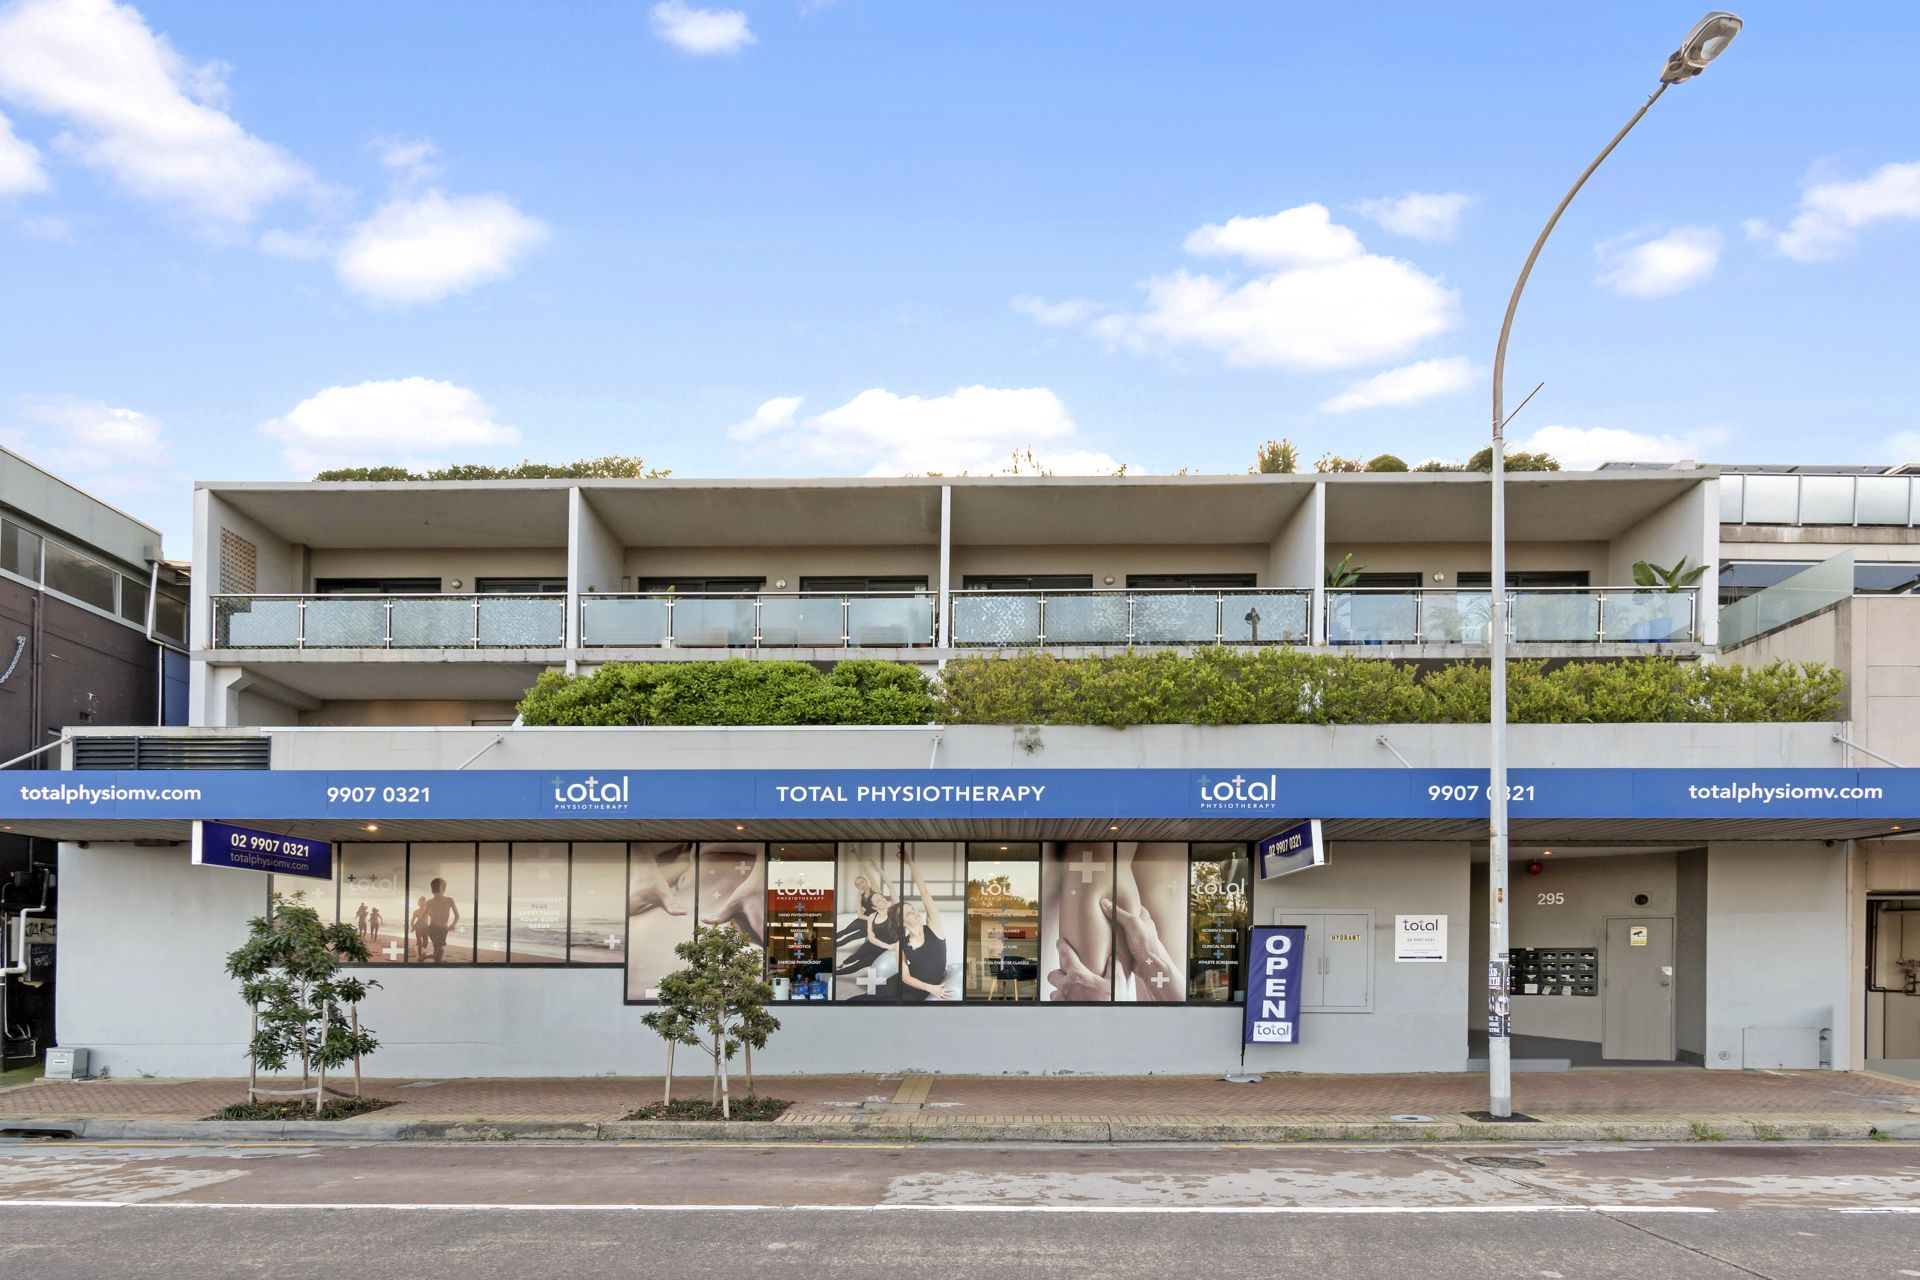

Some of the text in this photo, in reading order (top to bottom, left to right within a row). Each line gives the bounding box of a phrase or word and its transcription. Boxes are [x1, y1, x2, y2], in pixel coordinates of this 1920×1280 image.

[20, 784, 201, 804] totalphysiomv.com
[327, 787, 430, 803] 9907 0321
[551, 776, 628, 802] total
[776, 785, 1046, 802] TOTAL PHYSIOTHERAPY
[1197, 774, 1276, 801] total
[1428, 785, 1479, 801] 9907
[1688, 782, 1883, 803] totalphysiomv.com
[231, 833, 310, 857] 02 9907 0321
[1268, 833, 1302, 856] 02 9907 0321
[230, 851, 310, 871] totalphysiomv.com
[1537, 892, 1565, 905] 295
[1402, 918, 1438, 931] total
[1262, 935, 1291, 1019] OPEN
[1256, 1024, 1289, 1036] total
